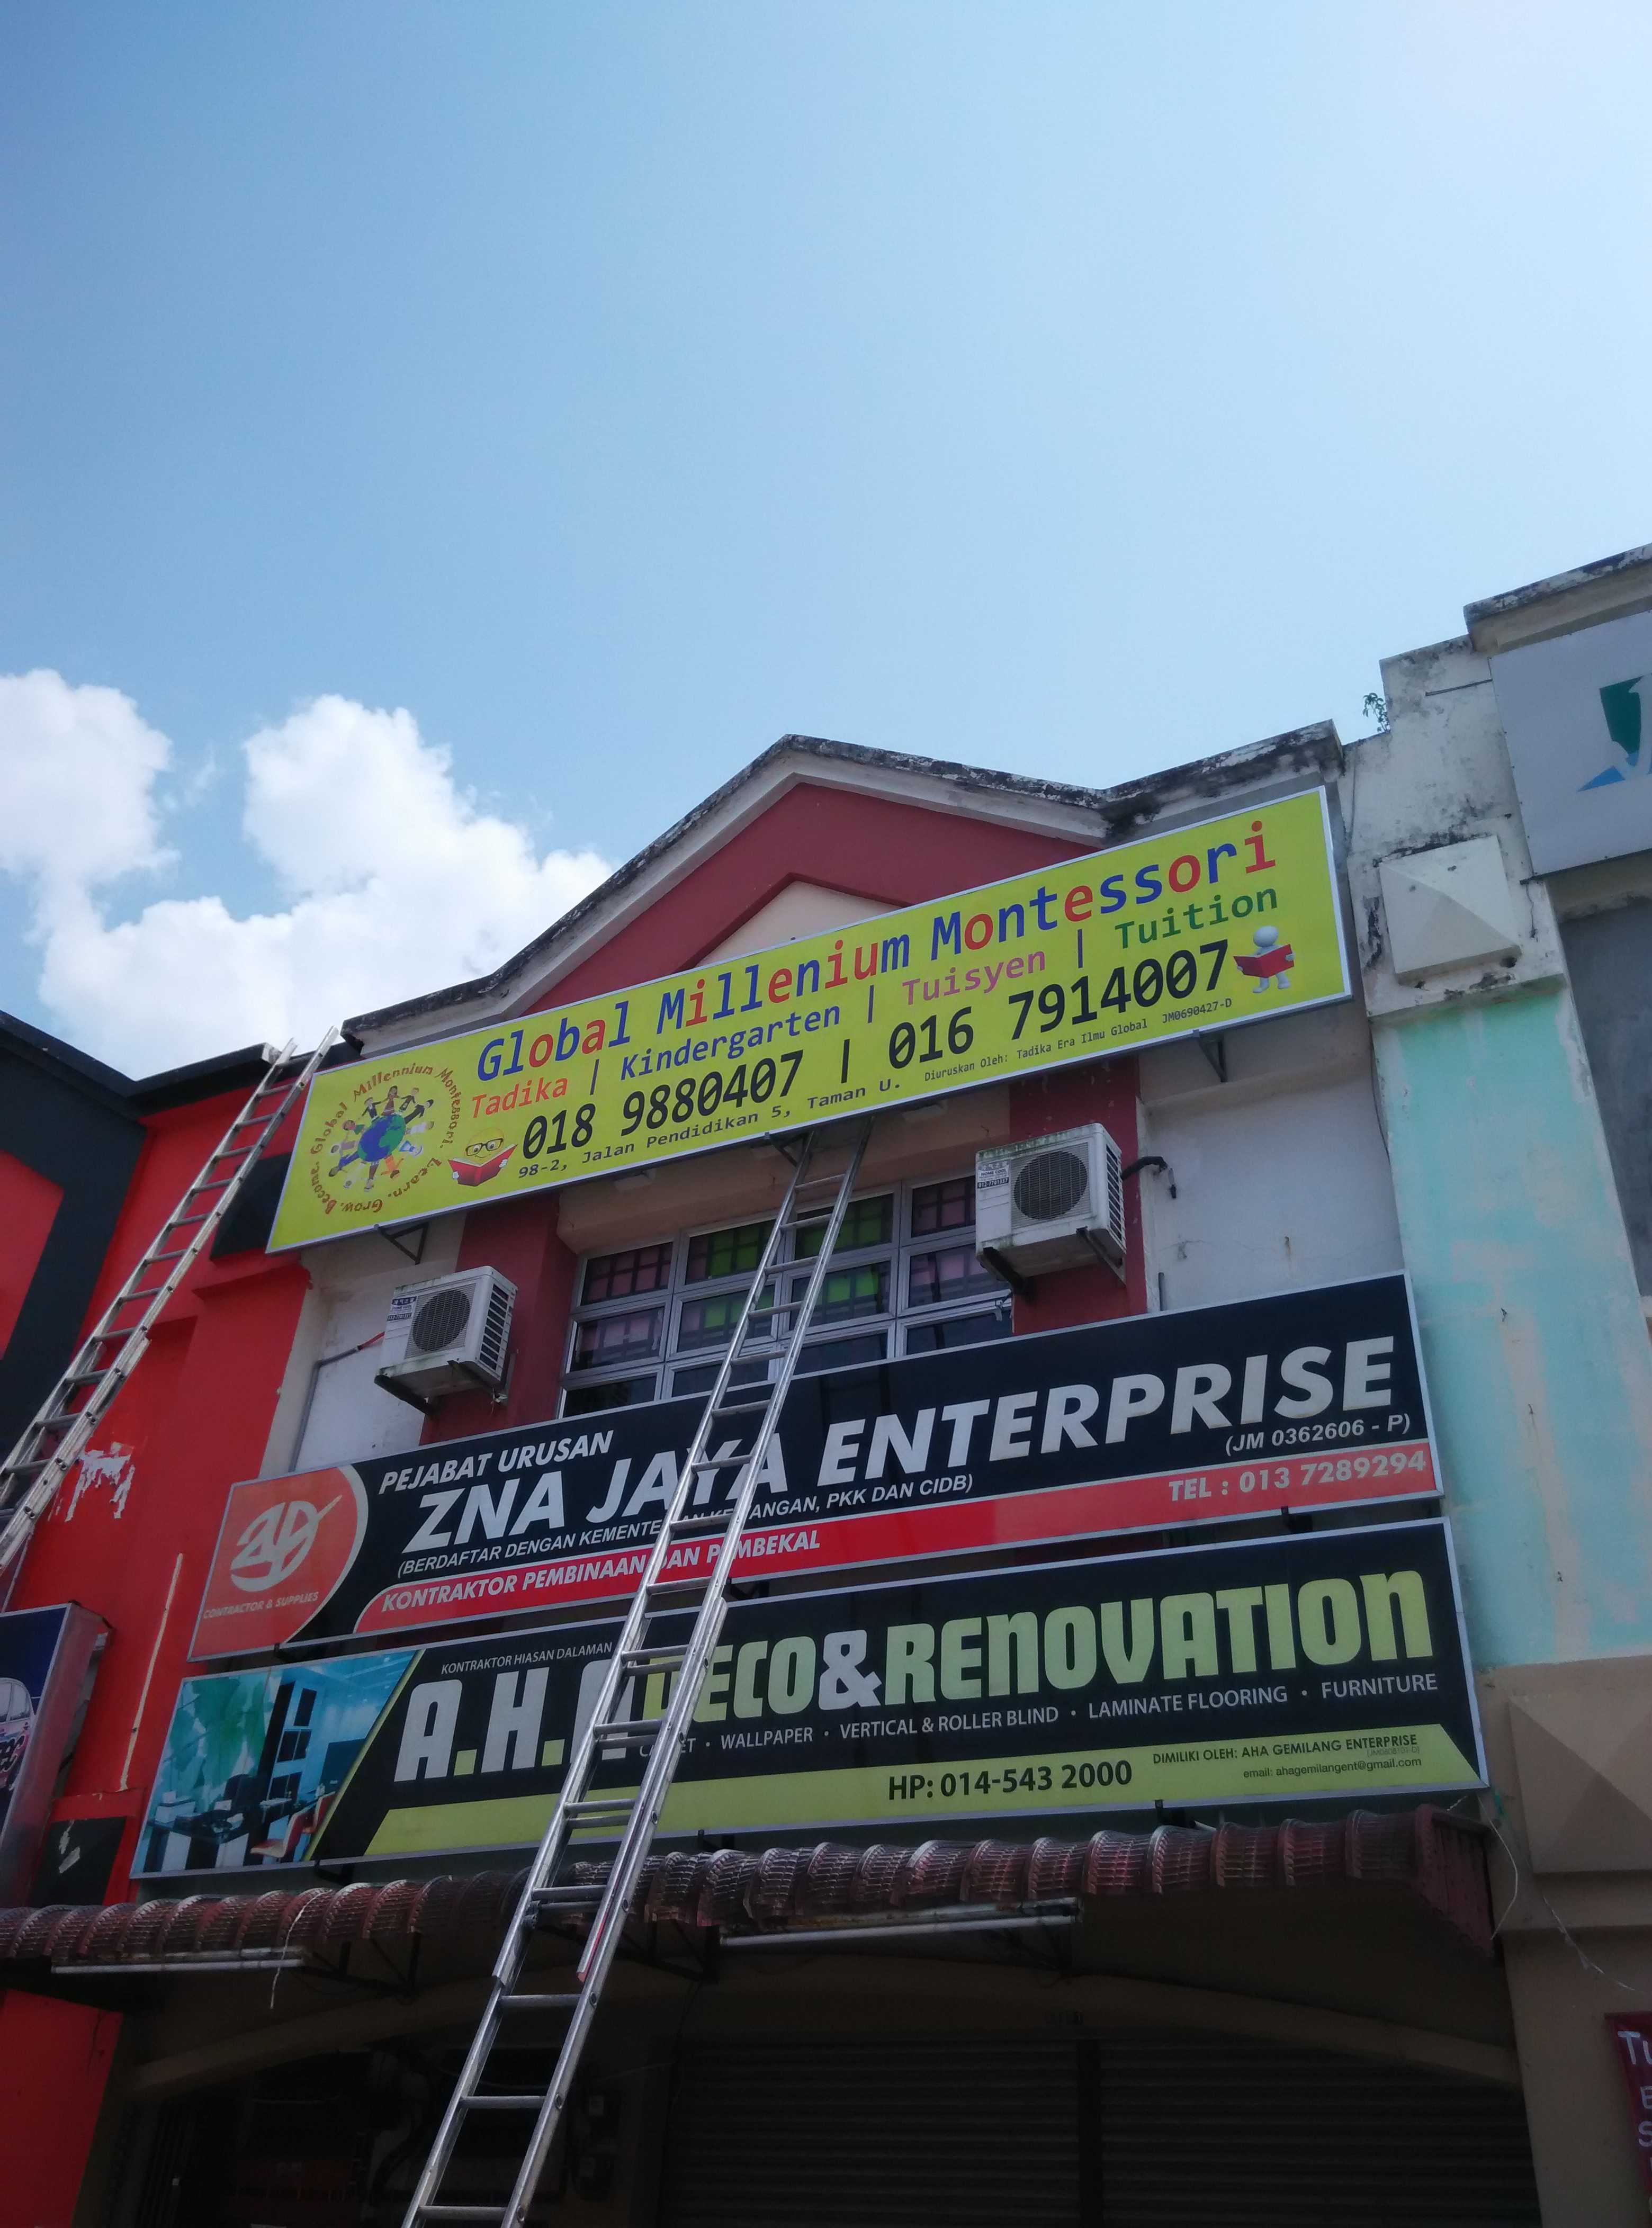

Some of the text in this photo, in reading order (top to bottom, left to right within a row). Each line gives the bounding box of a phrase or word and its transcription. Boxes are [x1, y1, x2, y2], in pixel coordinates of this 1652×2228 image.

[477, 821, 1276, 1081] Global Millenium Montessori
[472, 1077, 568, 1119] Tadika
[621, 1005, 840, 1081] Kindergarten
[902, 950, 1046, 1005] Tuisyen
[1115, 887, 1277, 949] Tuition
[924, 998, 1232, 1081] Diuruskan Oleh: Tadika Era Ilmu Global JM0690427-D
[522, 1103, 596, 1160] 018
[621, 1049, 804, 1137] 9880407
[888, 1007, 974, 1069] 016
[1008, 939, 1228, 1041] 7914007
[310, 1102, 347, 1154] Global
[353, 1063, 434, 1102] Millennium
[518, 1079, 900, 1179] 98-2, Jalan Pendidikan 5, Taman U.
[379, 1430, 614, 1495] PEJABAT URUSAN
[401, 1470, 565, 1553] ZNA
[586, 1432, 788, 1523] JAYA
[817, 1335, 1394, 1487] ENTERPRISE
[1225, 1431, 1264, 1456] (JM
[1271, 1419, 1364, 1447] 0362606
[1387, 1413, 1411, 1434] P)
[1169, 1477, 1211, 1502] TEL
[1240, 1467, 1290, 1493] 013
[1300, 1450, 1425, 1486] 7289294
[398, 1544, 502, 1578] (BERDAFTAR
[505, 1535, 574, 1557] DENGAN
[579, 1513, 700, 1545] KEMENTE
[826, 1487, 867, 1508] PKK
[871, 1482, 913, 1503] DAN
[919, 1473, 974, 1496] CIDB)
[203, 1592, 319, 1619] CONTRACTOR & SUPPLIES
[382, 1530, 820, 1612] KONTRAKTOR PEMBINAAN AN PMBEKAL
[441, 1642, 613, 1675] KONTRAKTOR HIASAN DALAMAN
[720, 1727, 813, 1750] WALLPAPER
[839, 1718, 918, 1739] VERTICAL
[921, 1715, 934, 1733] &
[938, 1712, 1002, 1732] ROLLER
[1007, 1706, 1059, 1727] BLIND
[1089, 1695, 1183, 1719] LAMINATE
[1188, 1685, 1288, 1710] FLOORING
[1321, 1673, 1438, 1699] FURNITURE
[1153, 1734, 1417, 1765] DIMILIKI OLEH: AHA GEMILANG ENTERPRISE
[888, 1759, 1133, 1801] HP: 014-543 2000
[1243, 1758, 1422, 1778] email: ahagemilangent@gmail.com
